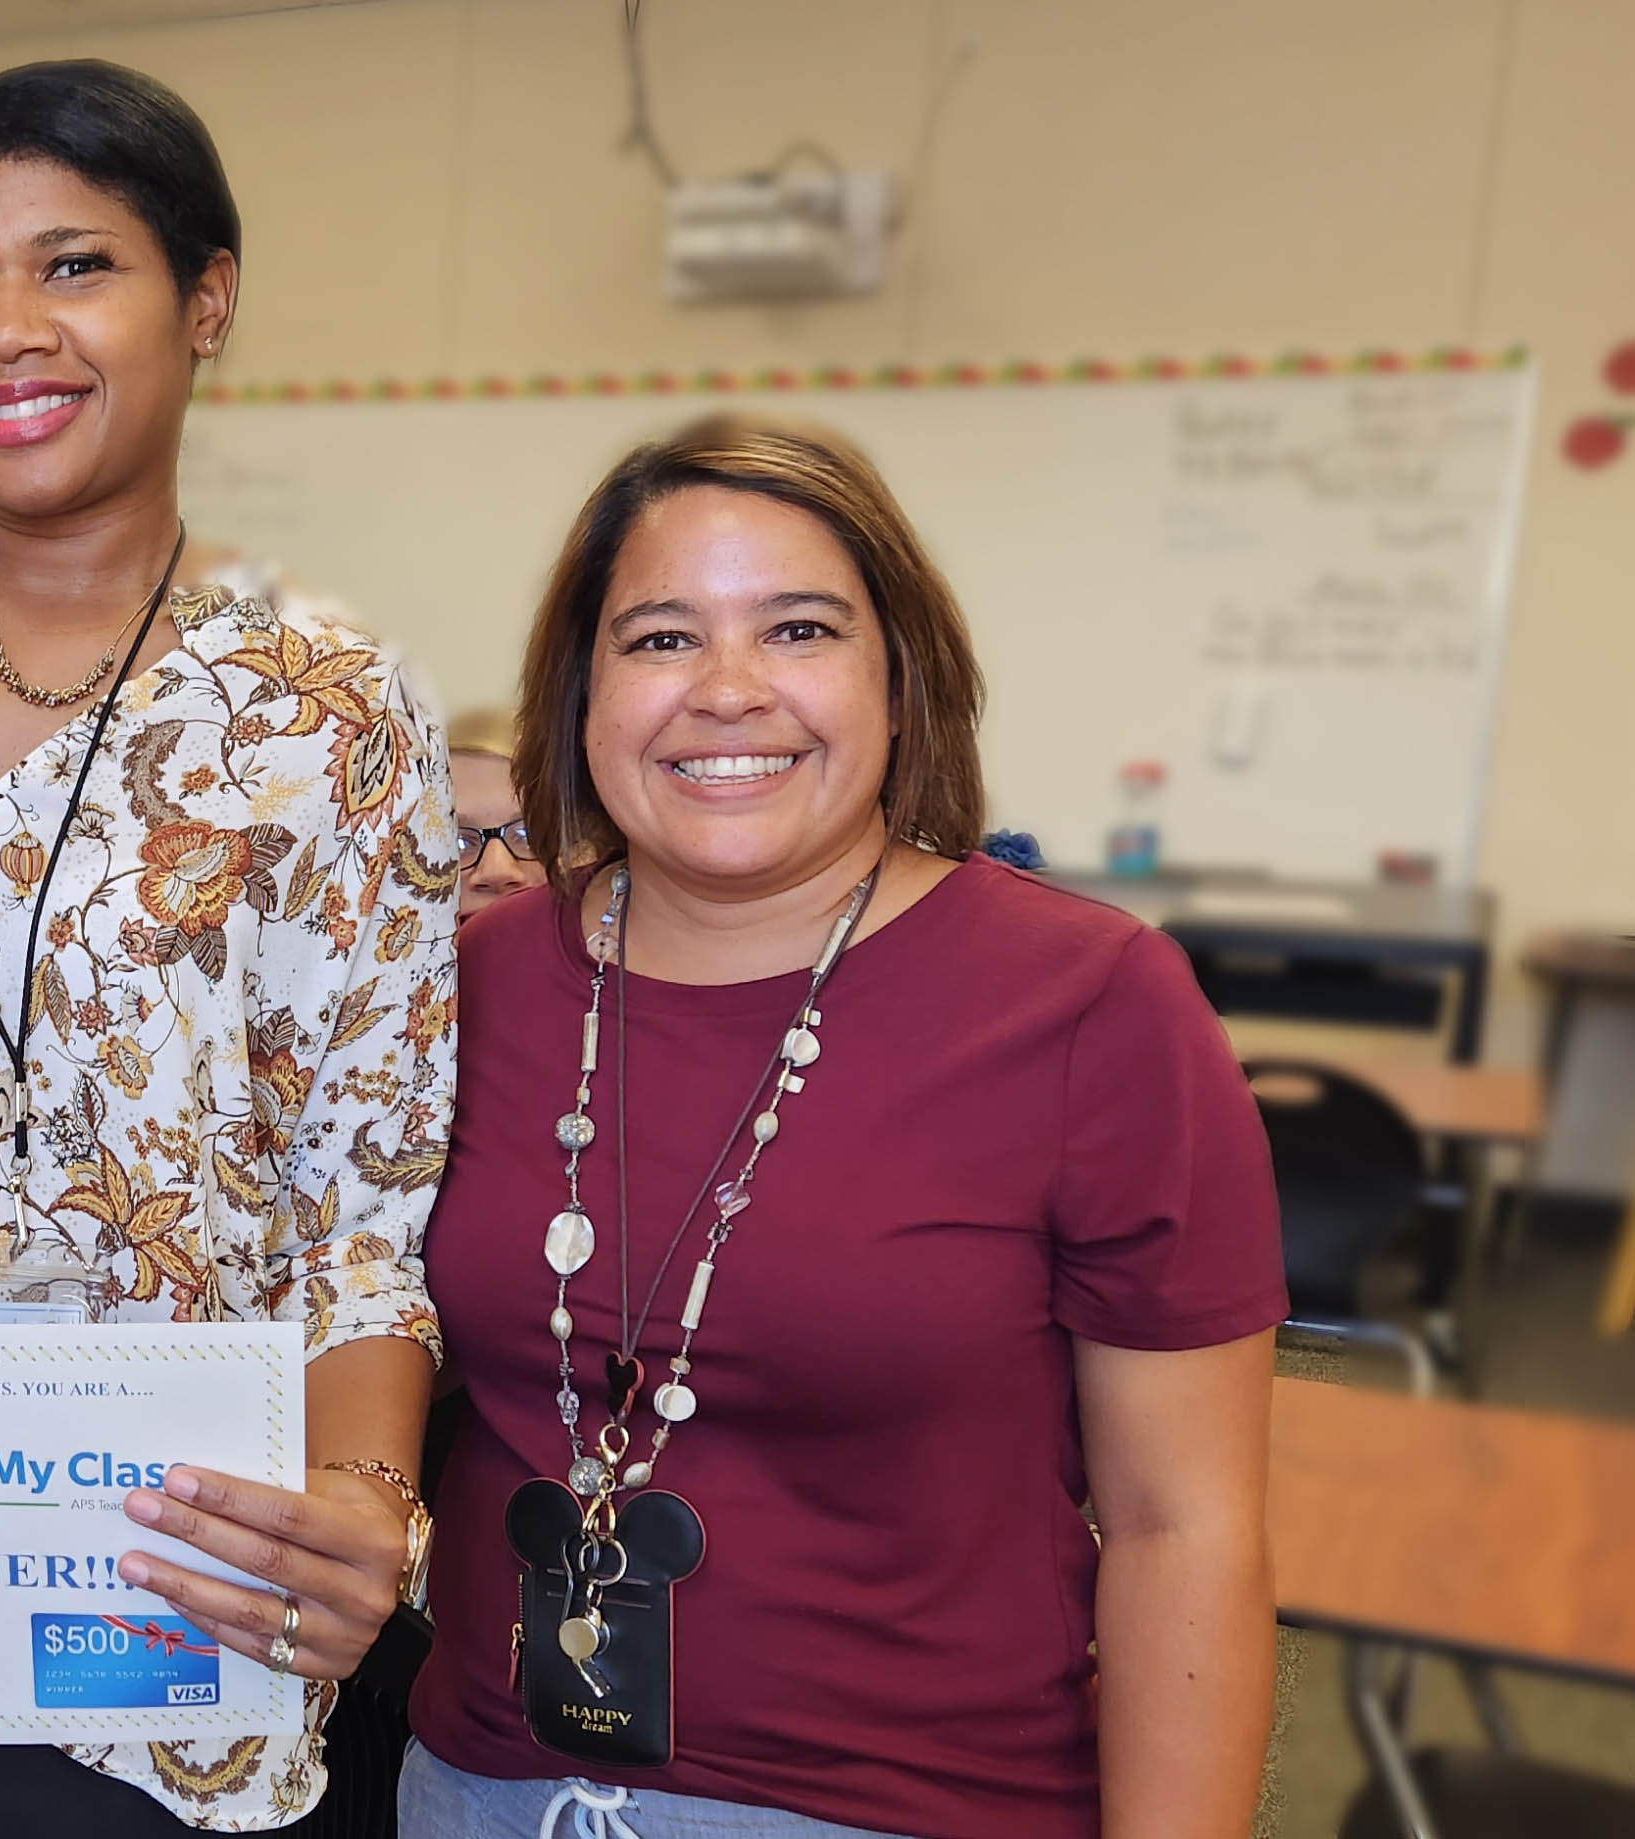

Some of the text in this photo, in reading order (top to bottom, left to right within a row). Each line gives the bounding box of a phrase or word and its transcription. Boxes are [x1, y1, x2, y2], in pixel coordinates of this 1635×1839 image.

[23, 1380, 65, 1397] YOU
[70, 1381, 111, 1397] ARE
[115, 1381, 155, 1398] A....
[67, 1451, 189, 1489] Clas
[71, 1498, 96, 1511] APS
[44, 1623, 129, 1657] $500
[172, 1686, 214, 1701] VISA
[562, 1703, 632, 1726] HAPPY
[581, 1721, 613, 1734] dream
